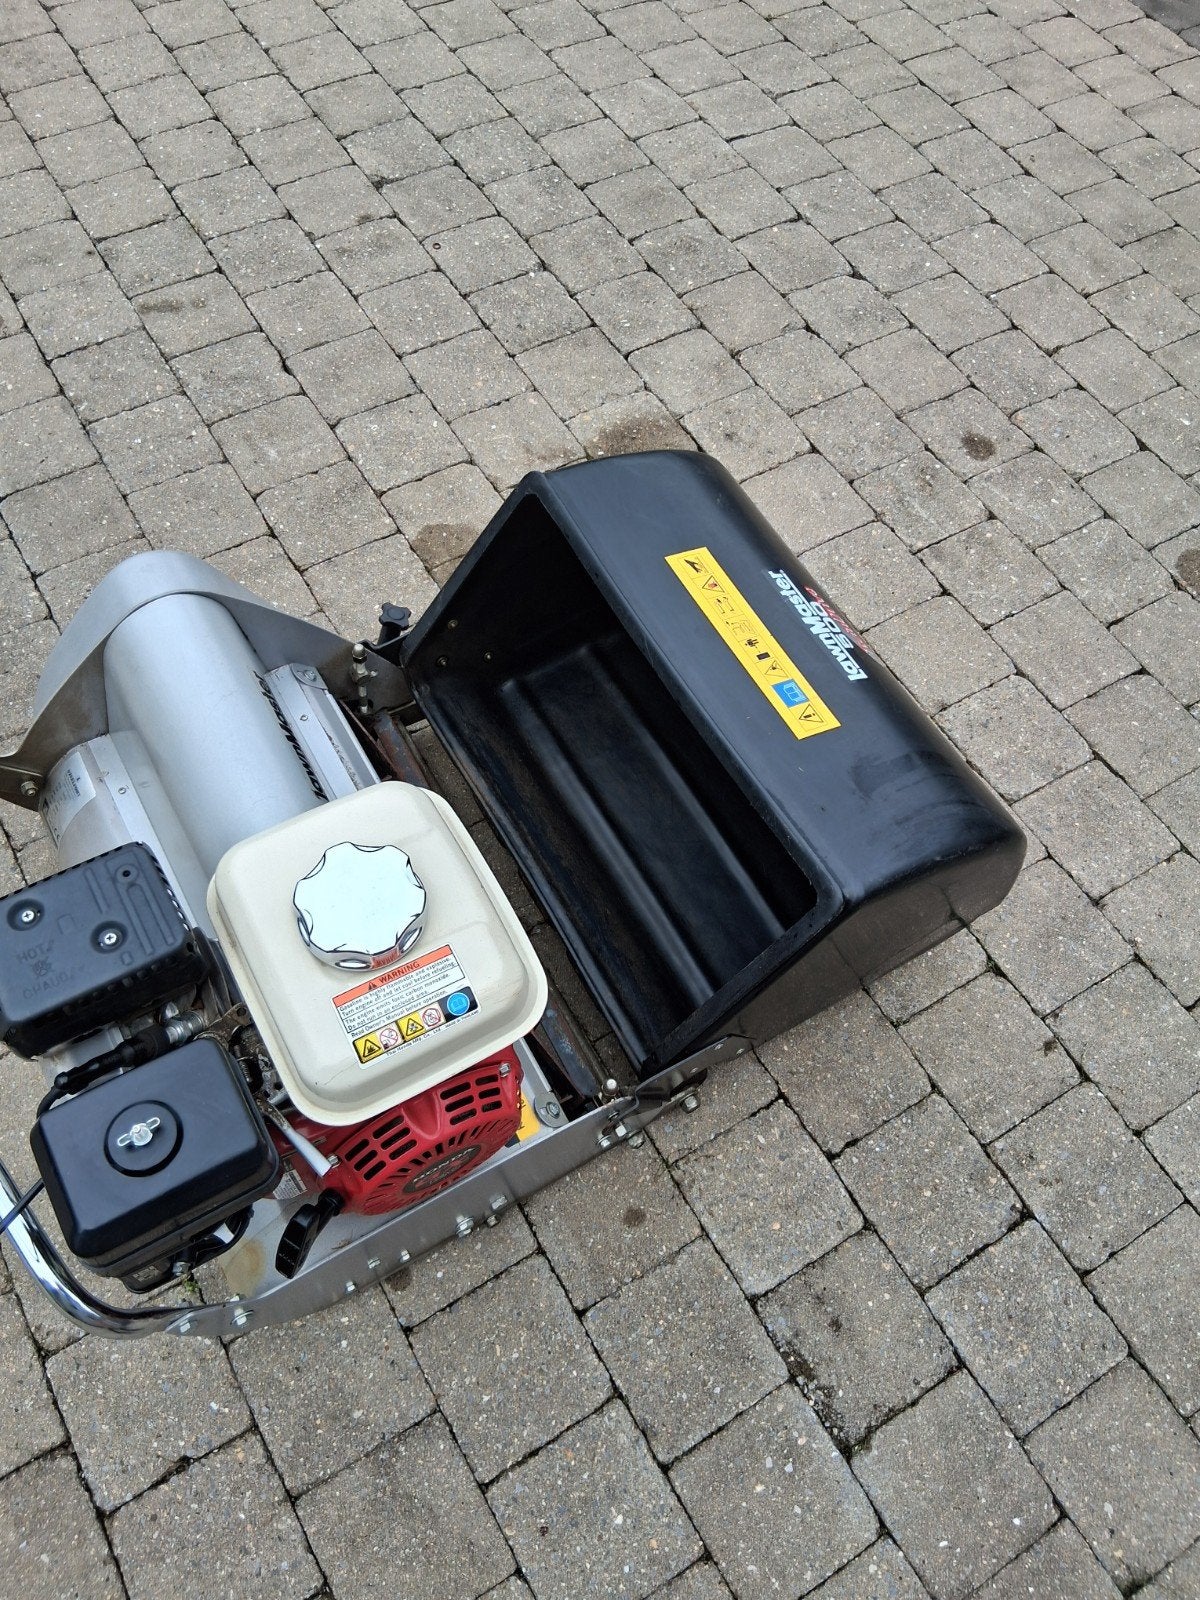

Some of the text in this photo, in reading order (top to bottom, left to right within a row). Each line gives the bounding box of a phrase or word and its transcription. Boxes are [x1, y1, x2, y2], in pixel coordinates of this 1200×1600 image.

[768, 570, 868, 681] LawnMaster
[810, 601, 854, 649] 500
[339, 998, 361, 1011] Gasoline
[369, 986, 386, 998] highly
[414, 968, 425, 976] and
[378, 960, 420, 984] WARNING
[342, 1008, 354, 1017] Turn
[354, 999, 373, 1011] engine
[382, 990, 393, 998] and
[401, 980, 413, 989] cool
[413, 972, 431, 983] before
[345, 1016, 356, 1024] The
[356, 1007, 375, 1020] engine
[375, 1000, 391, 1010] emits
[404, 984, 423, 996] carbon
[356, 1018, 365, 1026] not
[365, 1013, 376, 1021] run
[390, 995, 414, 1009] enclosed
[350, 1028, 364, 1037] Read
[385, 1008, 405, 1021] Manual
[404, 1000, 422, 1011] before
